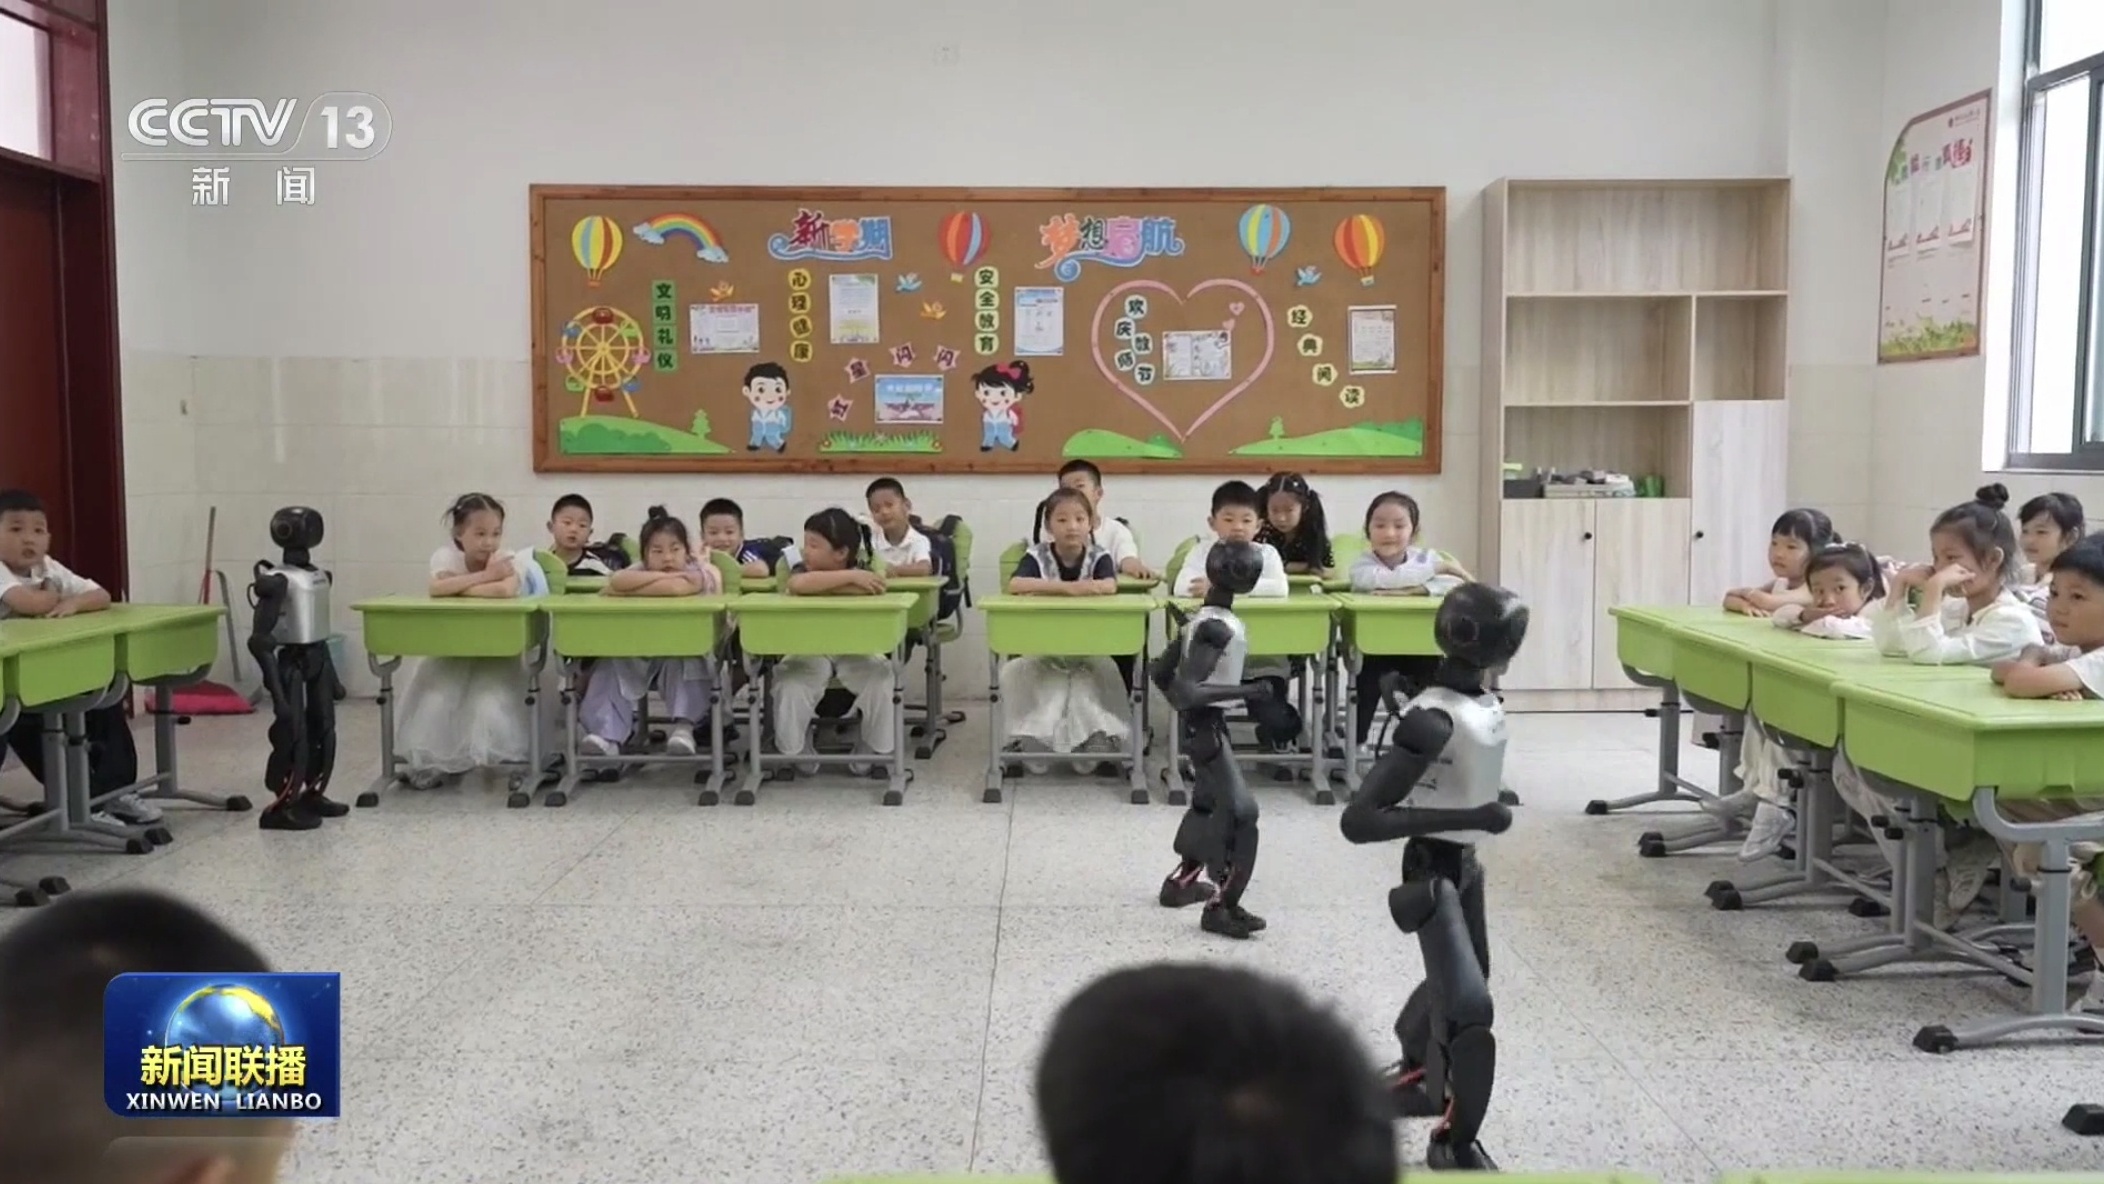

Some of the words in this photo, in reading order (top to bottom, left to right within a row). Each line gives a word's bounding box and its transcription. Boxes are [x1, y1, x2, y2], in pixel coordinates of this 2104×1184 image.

[786, 209, 892, 258] 新学期
[1036, 214, 1184, 268] 梦想启航
[655, 282, 674, 370] 文明礼仪
[792, 271, 810, 361] 心理健康
[978, 268, 996, 353] 安全教育
[1116, 298, 1153, 383] 欢庆教师节
[1291, 308, 1360, 405] 经典阅读
